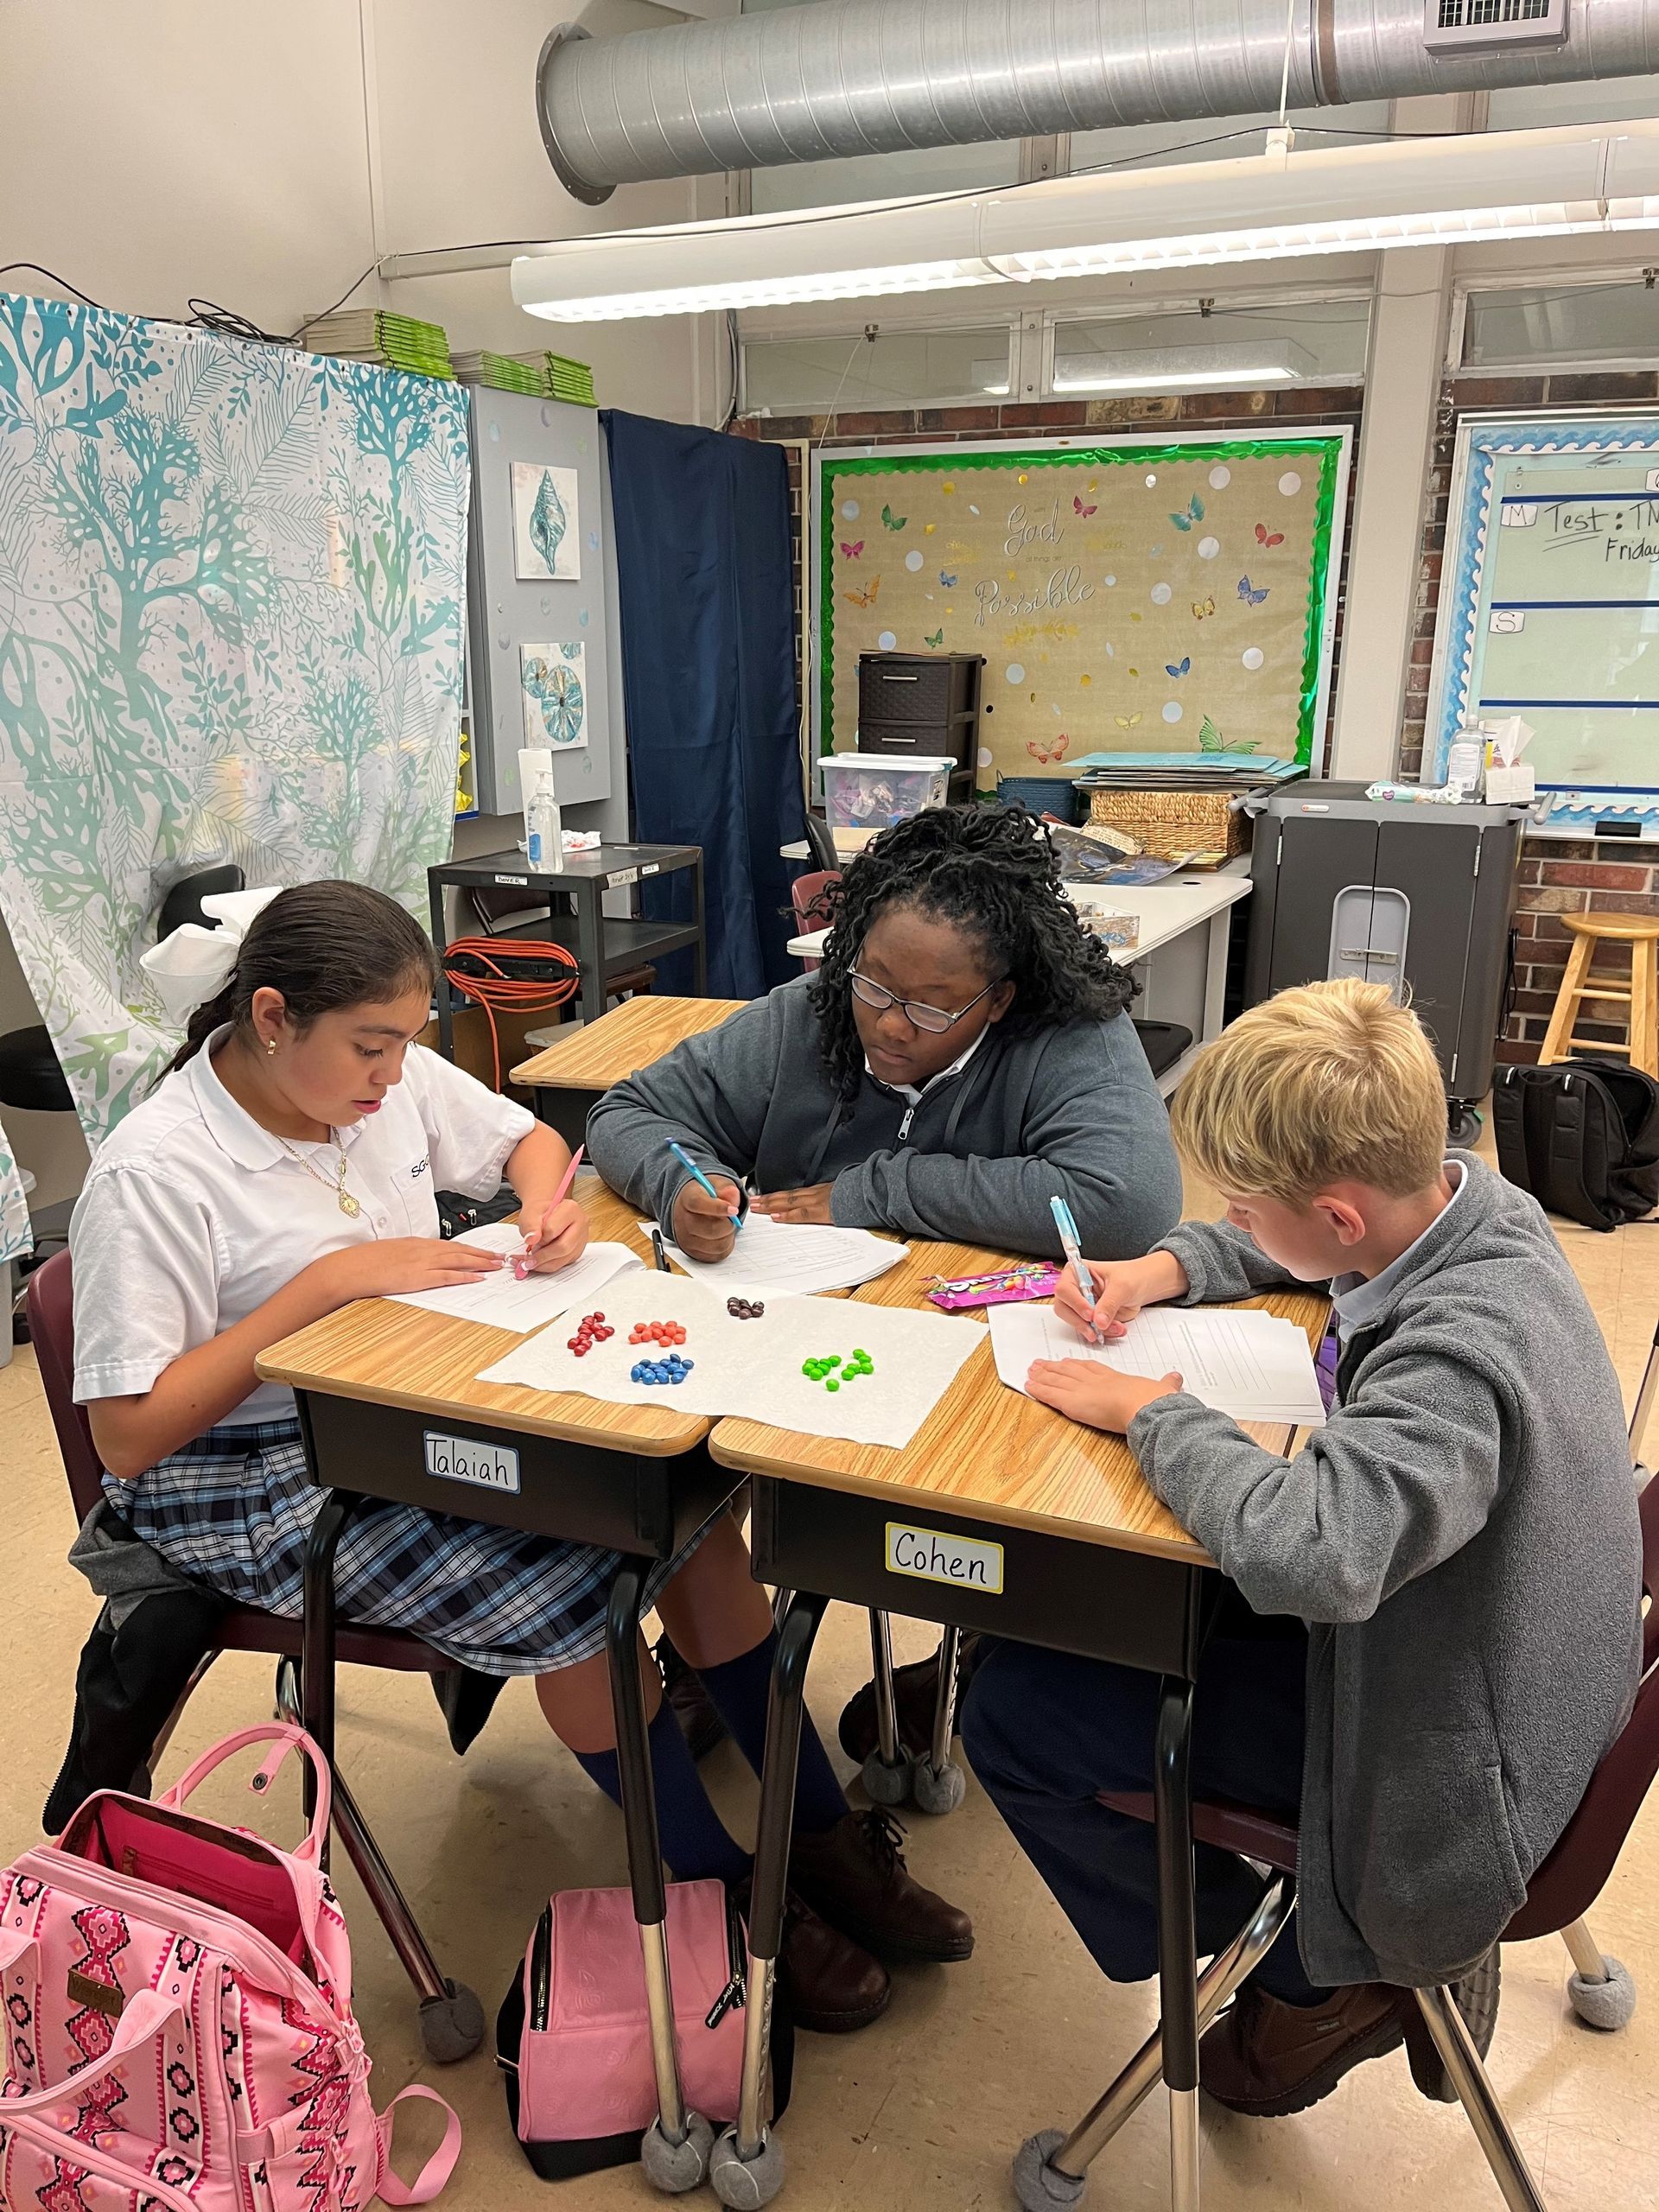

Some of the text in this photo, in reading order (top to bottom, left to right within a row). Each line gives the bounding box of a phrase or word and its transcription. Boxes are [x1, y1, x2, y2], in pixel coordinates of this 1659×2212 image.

[1004, 498, 1065, 556] God
[1509, 505, 1528, 526] M
[975, 564, 1096, 627] Possible
[1497, 611, 1516, 632] S
[426, 1439, 509, 1485] Talaiah
[895, 1532, 987, 1585] Cohen
